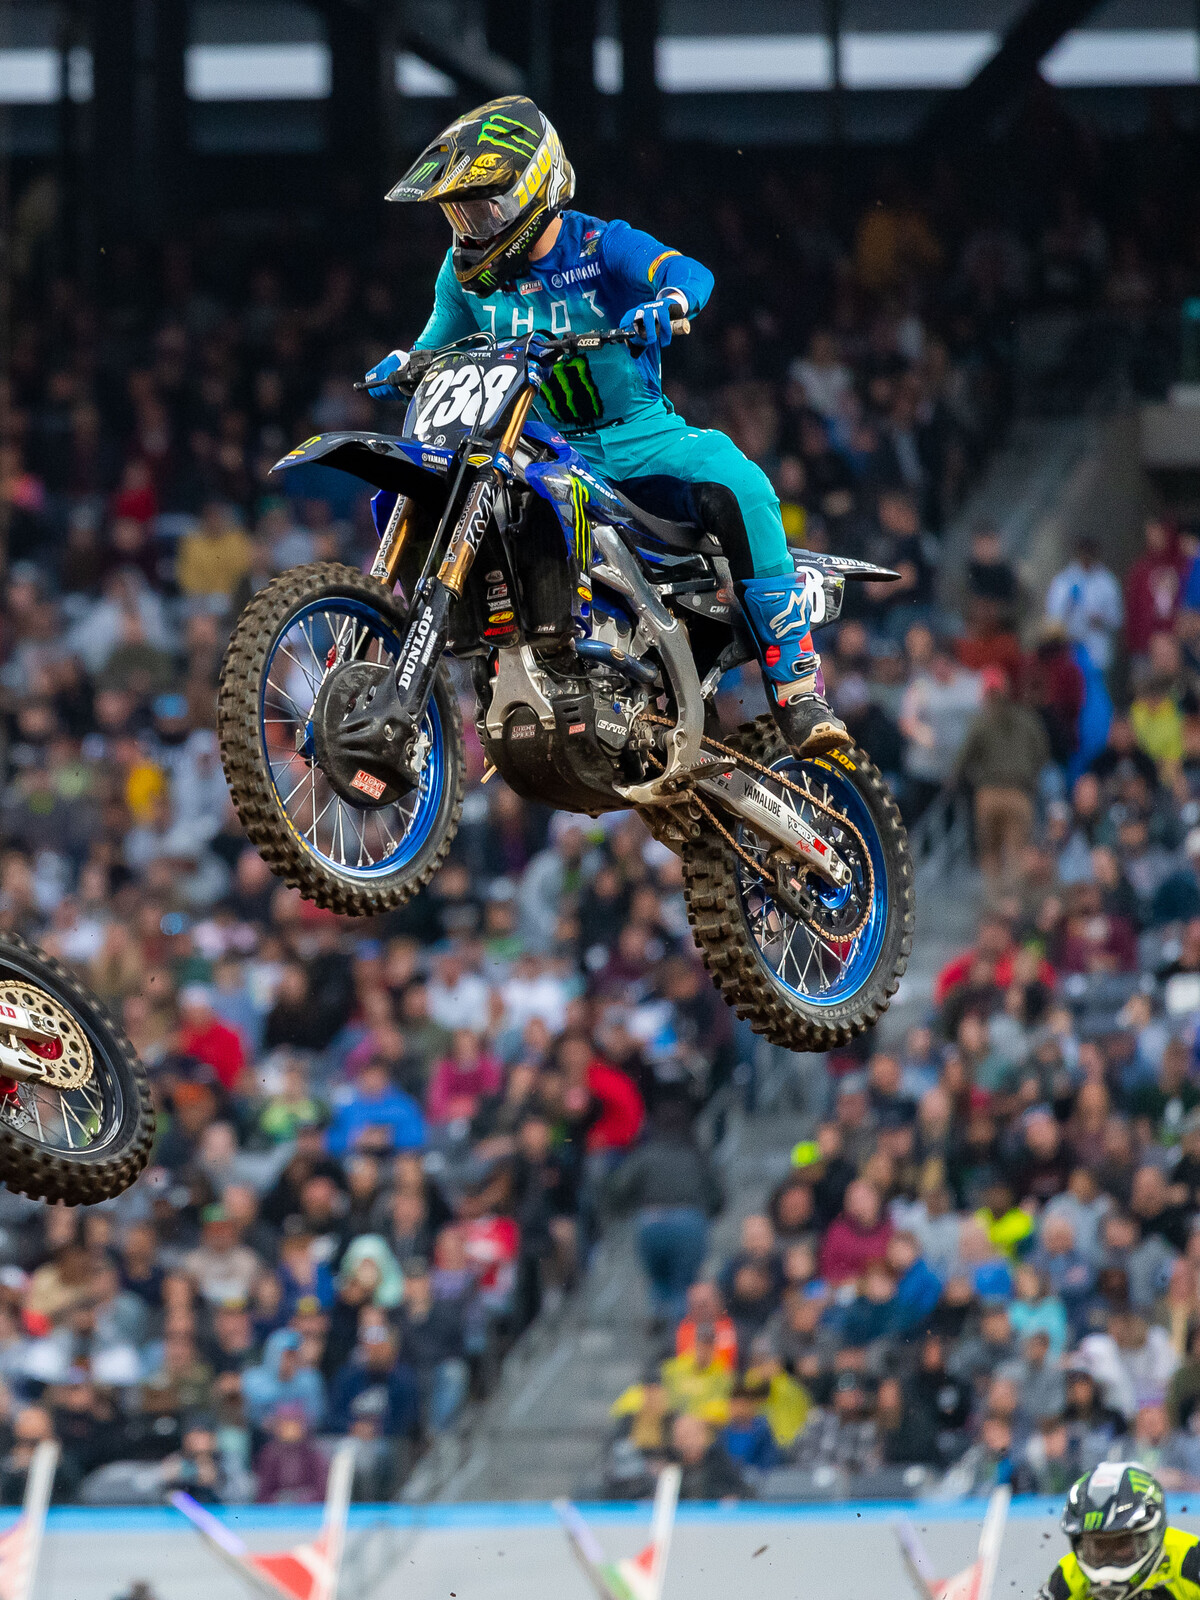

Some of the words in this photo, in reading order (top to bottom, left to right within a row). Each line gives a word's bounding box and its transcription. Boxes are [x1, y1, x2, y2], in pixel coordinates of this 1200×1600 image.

[512, 132, 560, 208] 100%
[561, 261, 602, 285] YAMAHA
[459, 351, 492, 360] MNSTER
[413, 364, 518, 435] 238
[427, 453, 448, 466] YAMAHA
[379, 494, 408, 559] nzoracing
[452, 480, 482, 545] enzoracin
[398, 606, 434, 691] DUNLOP
[353, 779, 381, 797] SPEED
[357, 772, 385, 791] LIGHT
[744, 782, 782, 818] YAMALUBE
